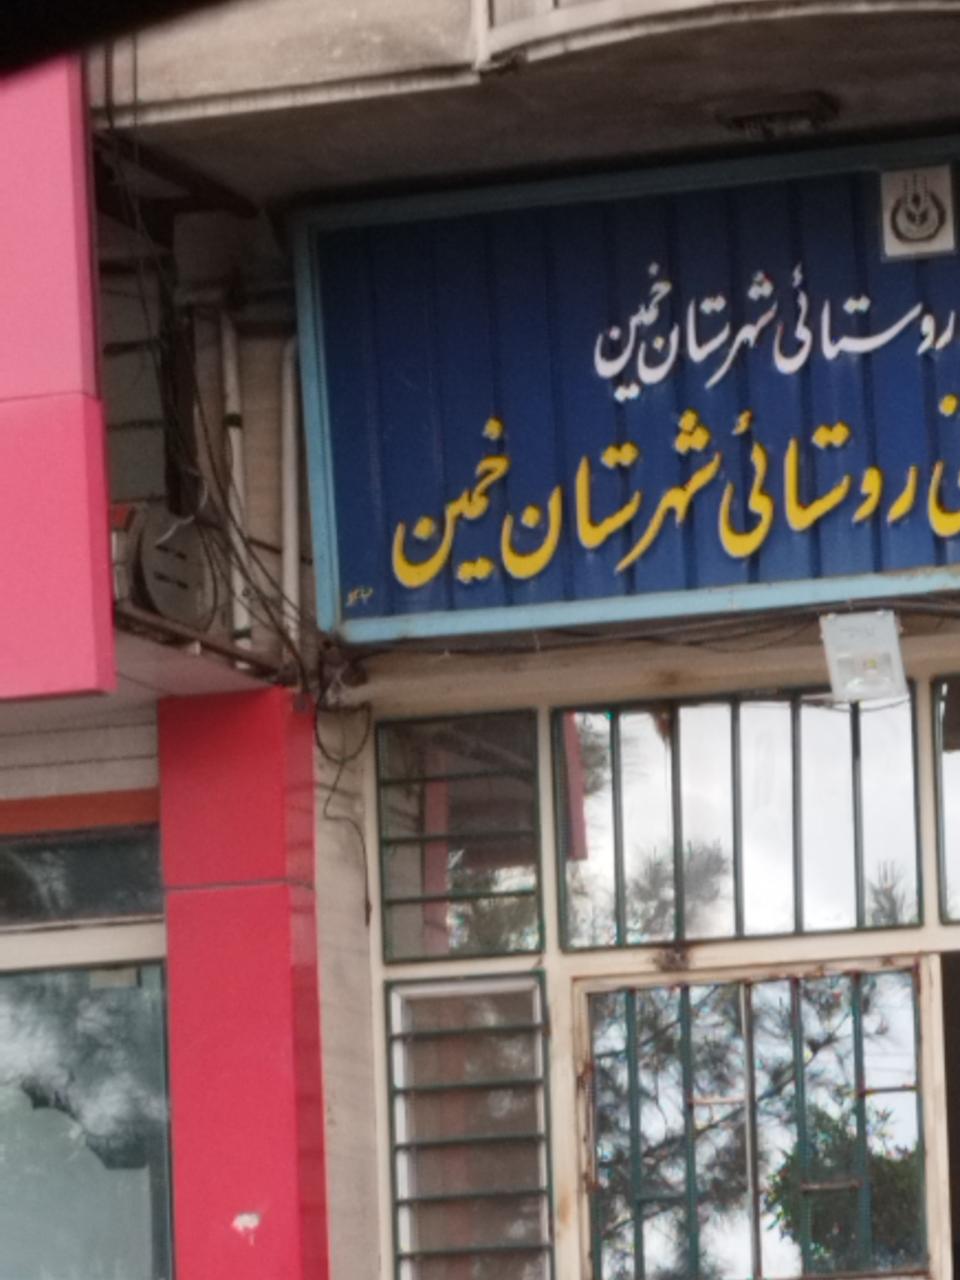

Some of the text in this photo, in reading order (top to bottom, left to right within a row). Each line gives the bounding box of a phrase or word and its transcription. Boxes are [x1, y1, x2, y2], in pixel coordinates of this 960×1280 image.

[593, 262, 672, 401] خمین
[636, 270, 779, 389] شهرستان
[391, 416, 511, 588] خمین
[501, 409, 723, 579] شهرستان
